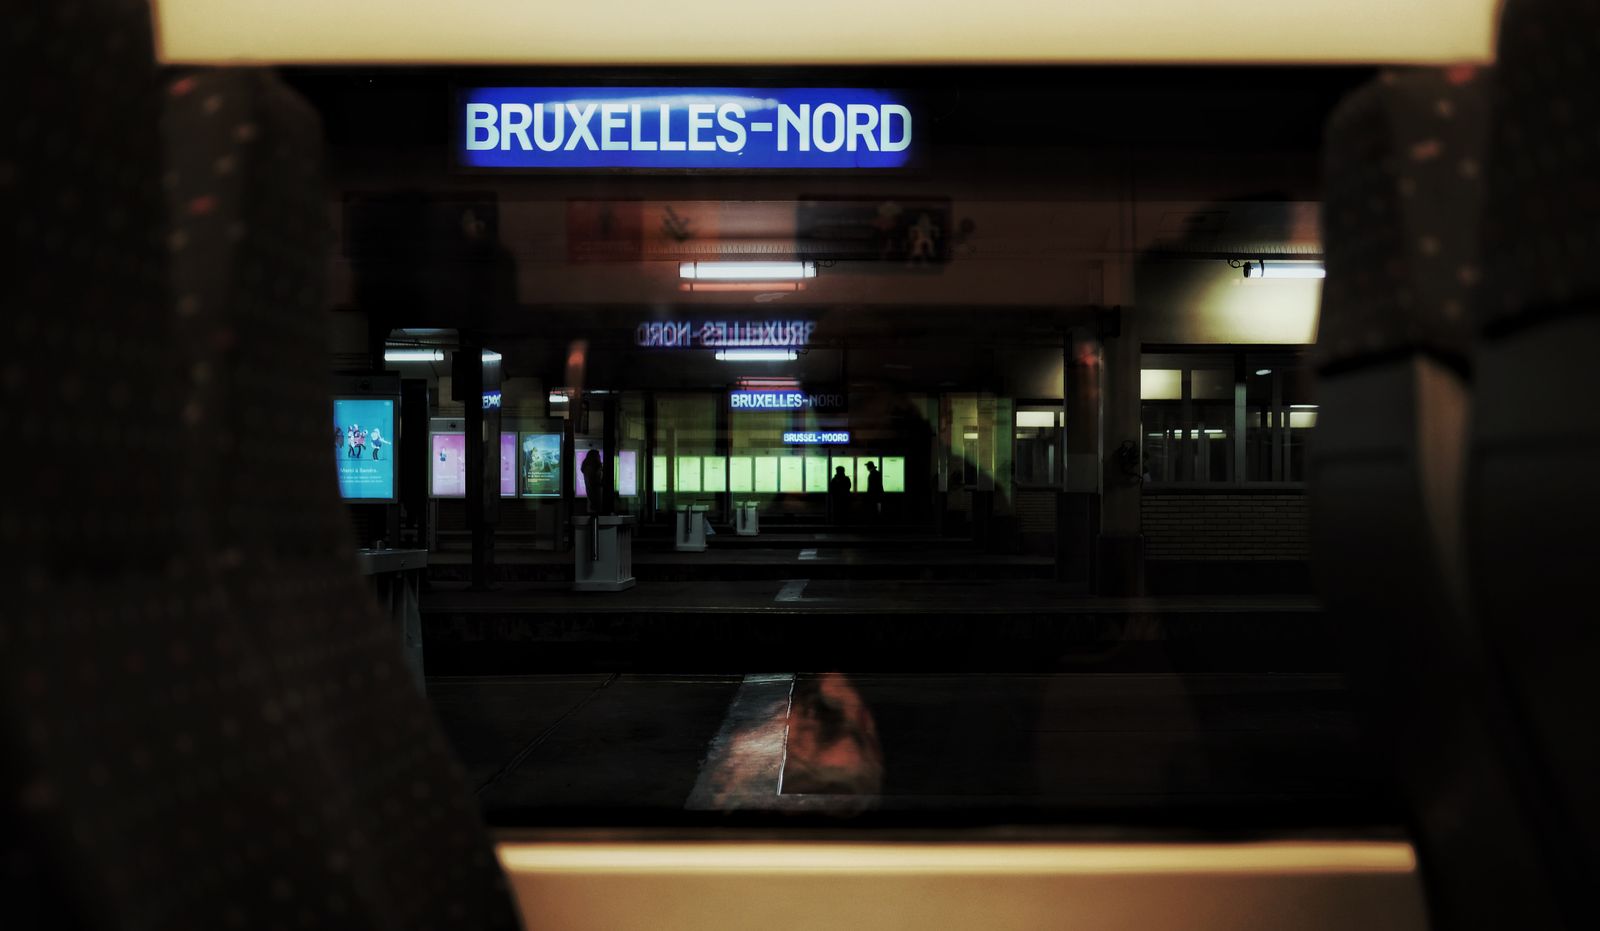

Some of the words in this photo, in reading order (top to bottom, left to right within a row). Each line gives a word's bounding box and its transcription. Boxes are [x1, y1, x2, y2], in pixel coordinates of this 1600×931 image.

[465, 101, 913, 153] BRUXELLES-NORD
[730, 393, 844, 408] BRUXELLES-NORD
[783, 432, 849, 443] BRUSSEL-NOORD
